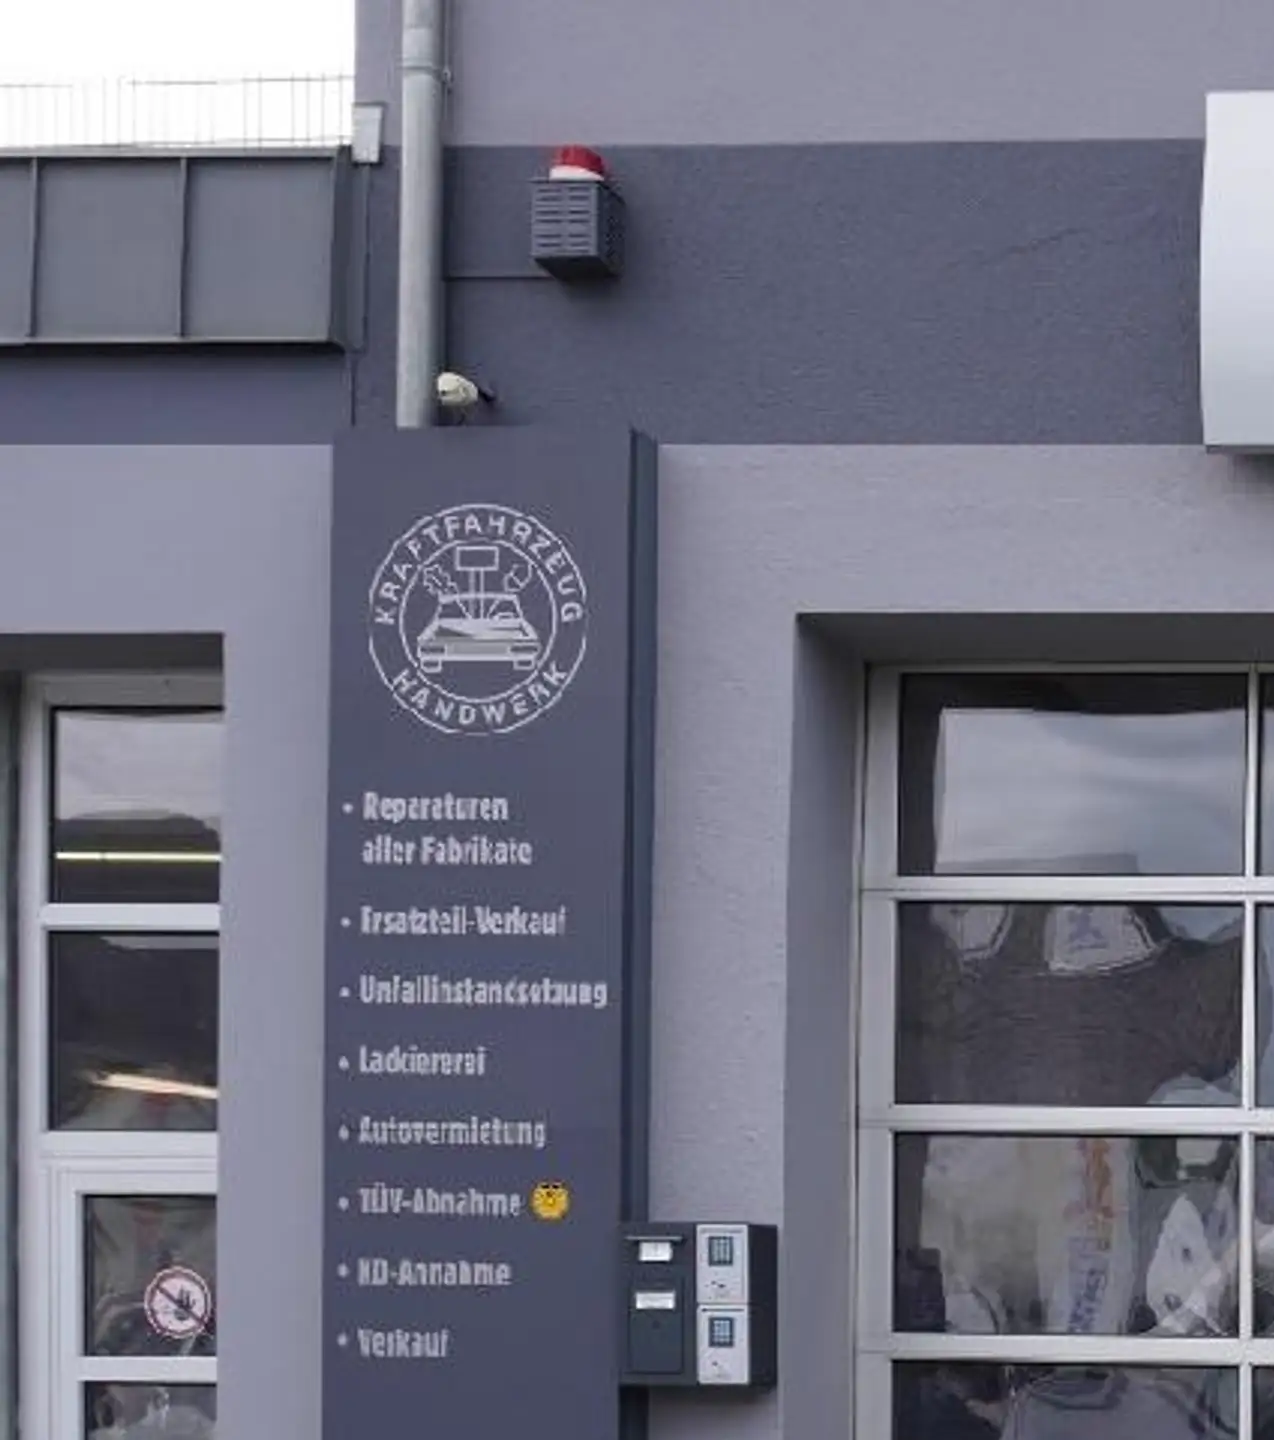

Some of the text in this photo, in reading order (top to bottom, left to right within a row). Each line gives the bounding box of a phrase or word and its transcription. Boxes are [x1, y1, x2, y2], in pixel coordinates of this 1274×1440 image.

[374, 514, 583, 625] KRAFTFAHRZEUG
[392, 662, 568, 725] HANDWERK
[362, 791, 509, 823] Reparaturen
[362, 834, 533, 865] aller Fabrikate
[360, 904, 567, 935] Ersatzteil-Verkauf
[359, 974, 608, 1009] Unfallinstandsetzung
[359, 1044, 487, 1075] Lackiererei
[358, 1115, 547, 1149] Autovermietung
[359, 1182, 523, 1217] TÜV-Abnahme
[357, 1328, 449, 1358] Verkauf
